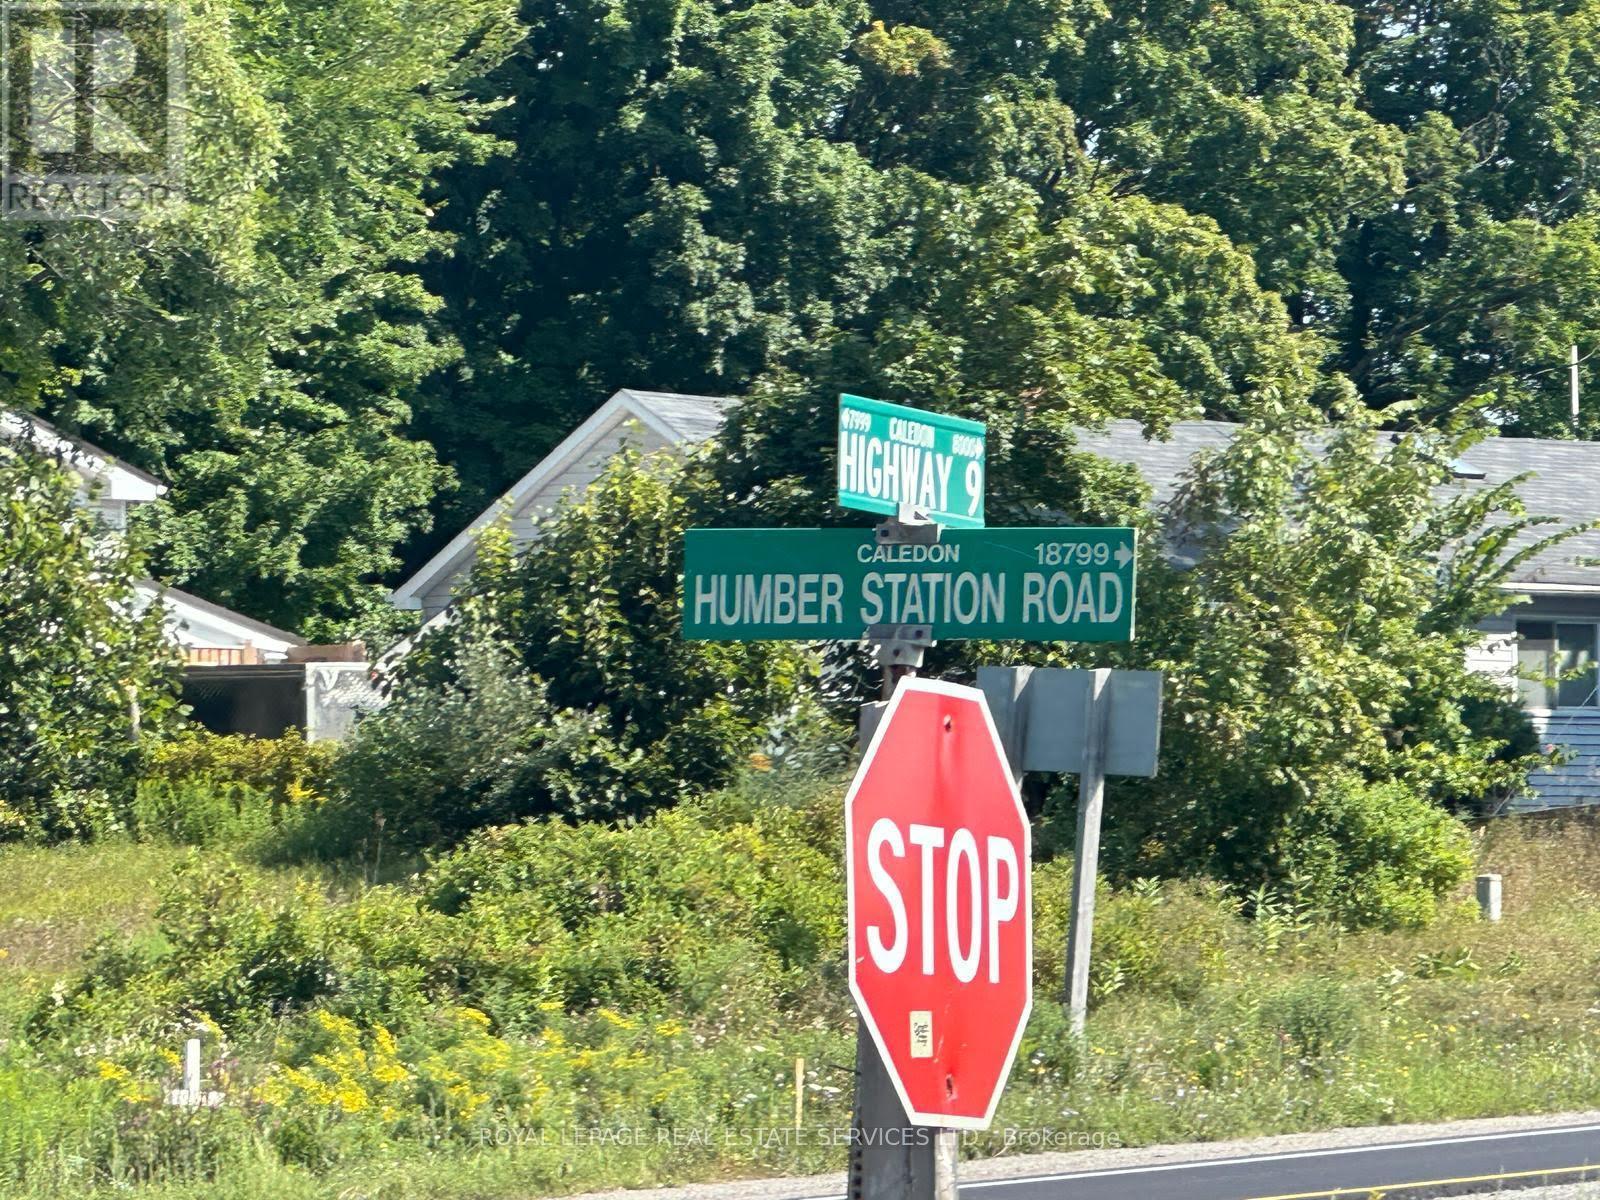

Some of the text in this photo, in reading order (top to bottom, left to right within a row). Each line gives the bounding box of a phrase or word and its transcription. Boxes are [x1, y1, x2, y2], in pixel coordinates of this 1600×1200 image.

[889, 417, 935, 448] CALEDON
[840, 431, 982, 516] HIGHWAY 9
[857, 543, 960, 563] CALEDON
[1034, 543, 1109, 566] 18799
[694, 572, 1123, 625] HUMBER STATION ROAD
[866, 818, 1019, 983] STOP
